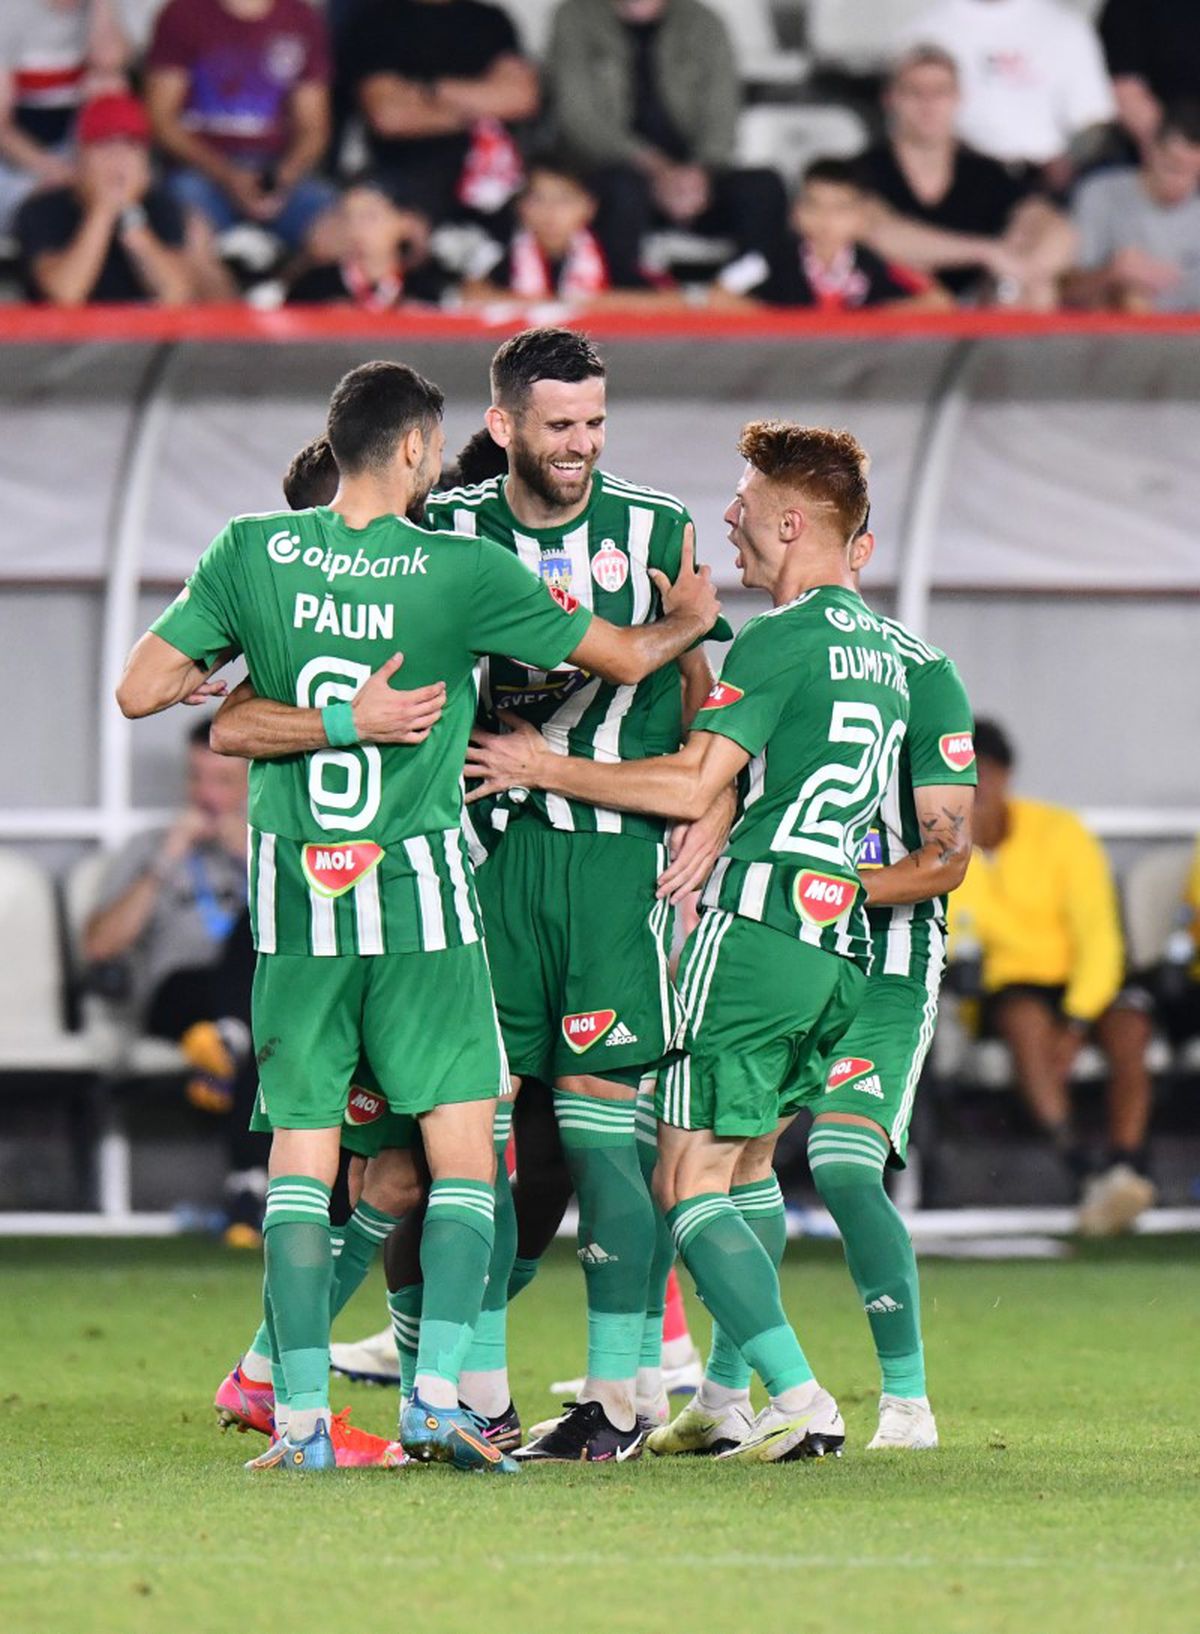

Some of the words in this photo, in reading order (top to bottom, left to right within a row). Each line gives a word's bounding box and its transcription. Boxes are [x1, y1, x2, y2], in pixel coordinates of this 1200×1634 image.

[315, 850, 356, 870] MOL
[803, 879, 845, 906] MOL
[569, 1016, 597, 1034] MOL
[351, 1093, 379, 1114] MOL
